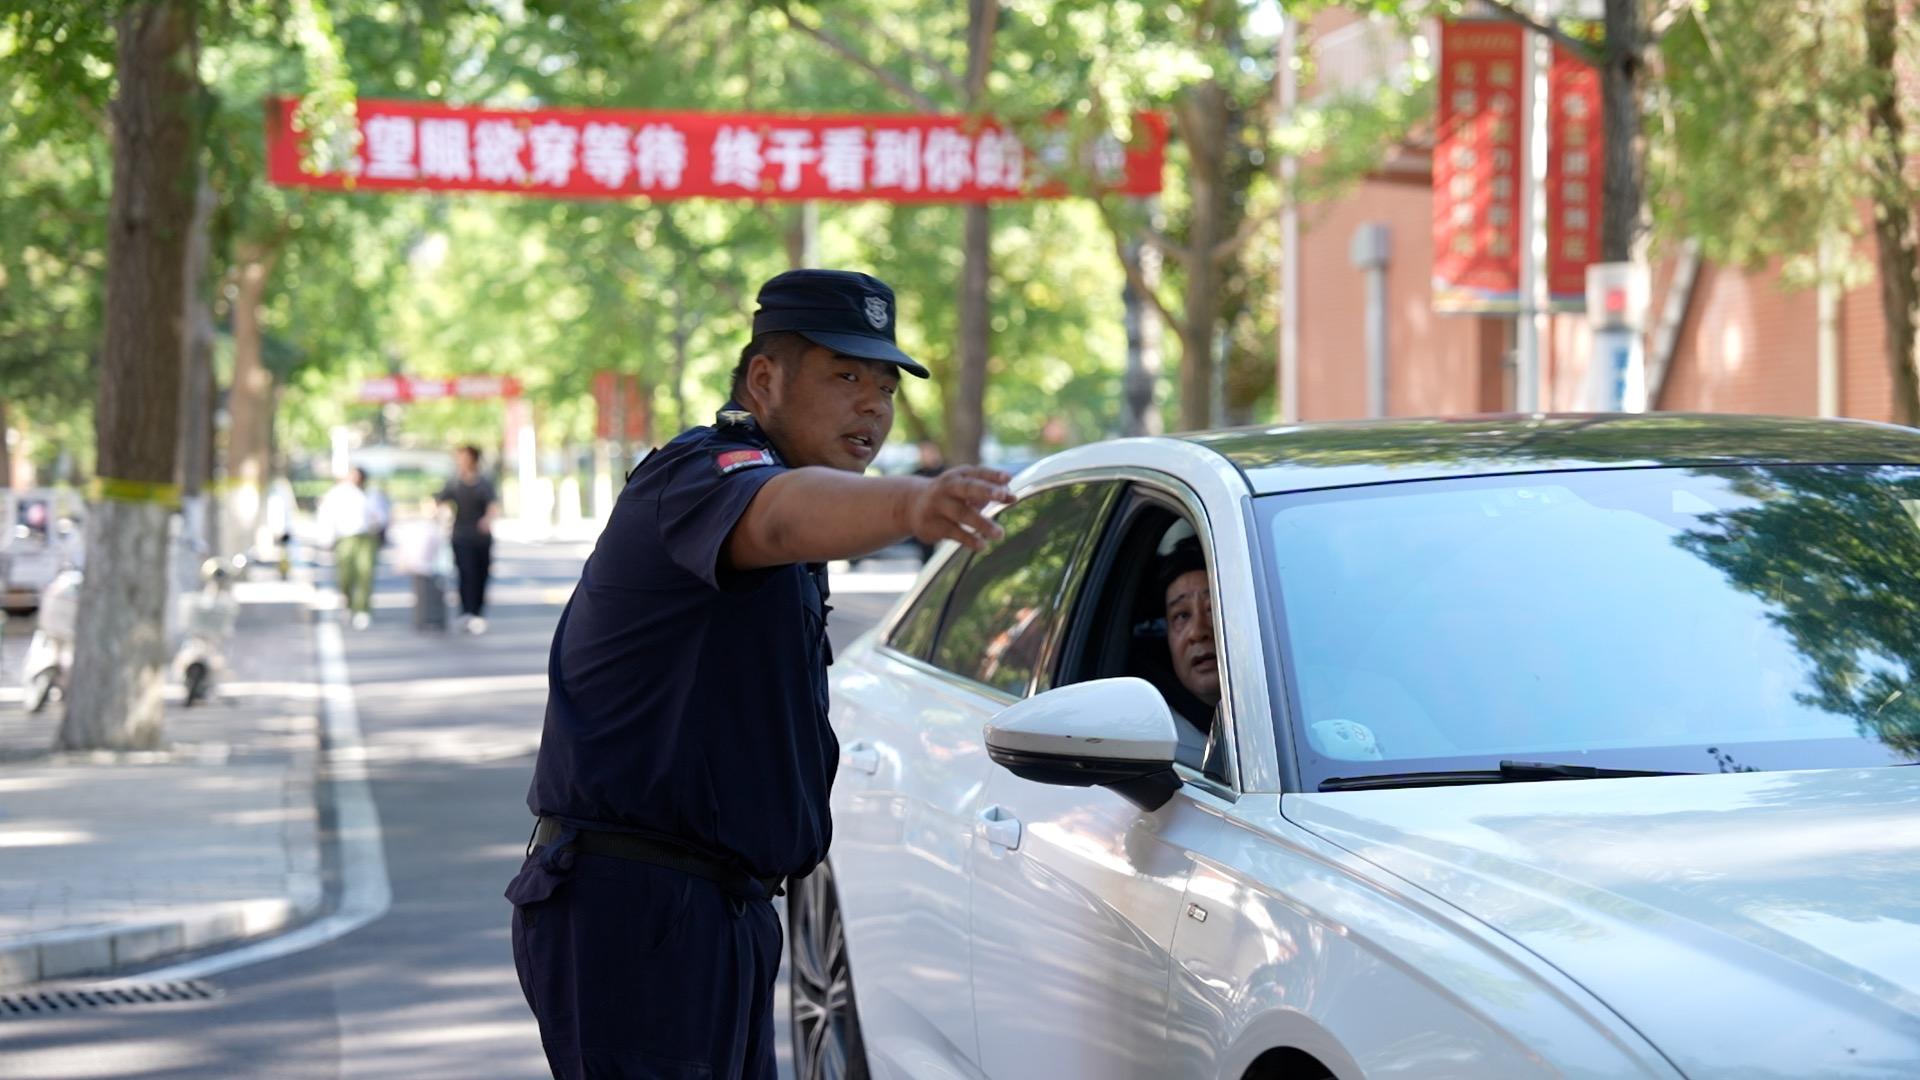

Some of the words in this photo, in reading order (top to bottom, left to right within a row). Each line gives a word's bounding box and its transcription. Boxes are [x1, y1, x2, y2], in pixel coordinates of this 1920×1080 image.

[711, 124, 1126, 192] 终于看到你的
